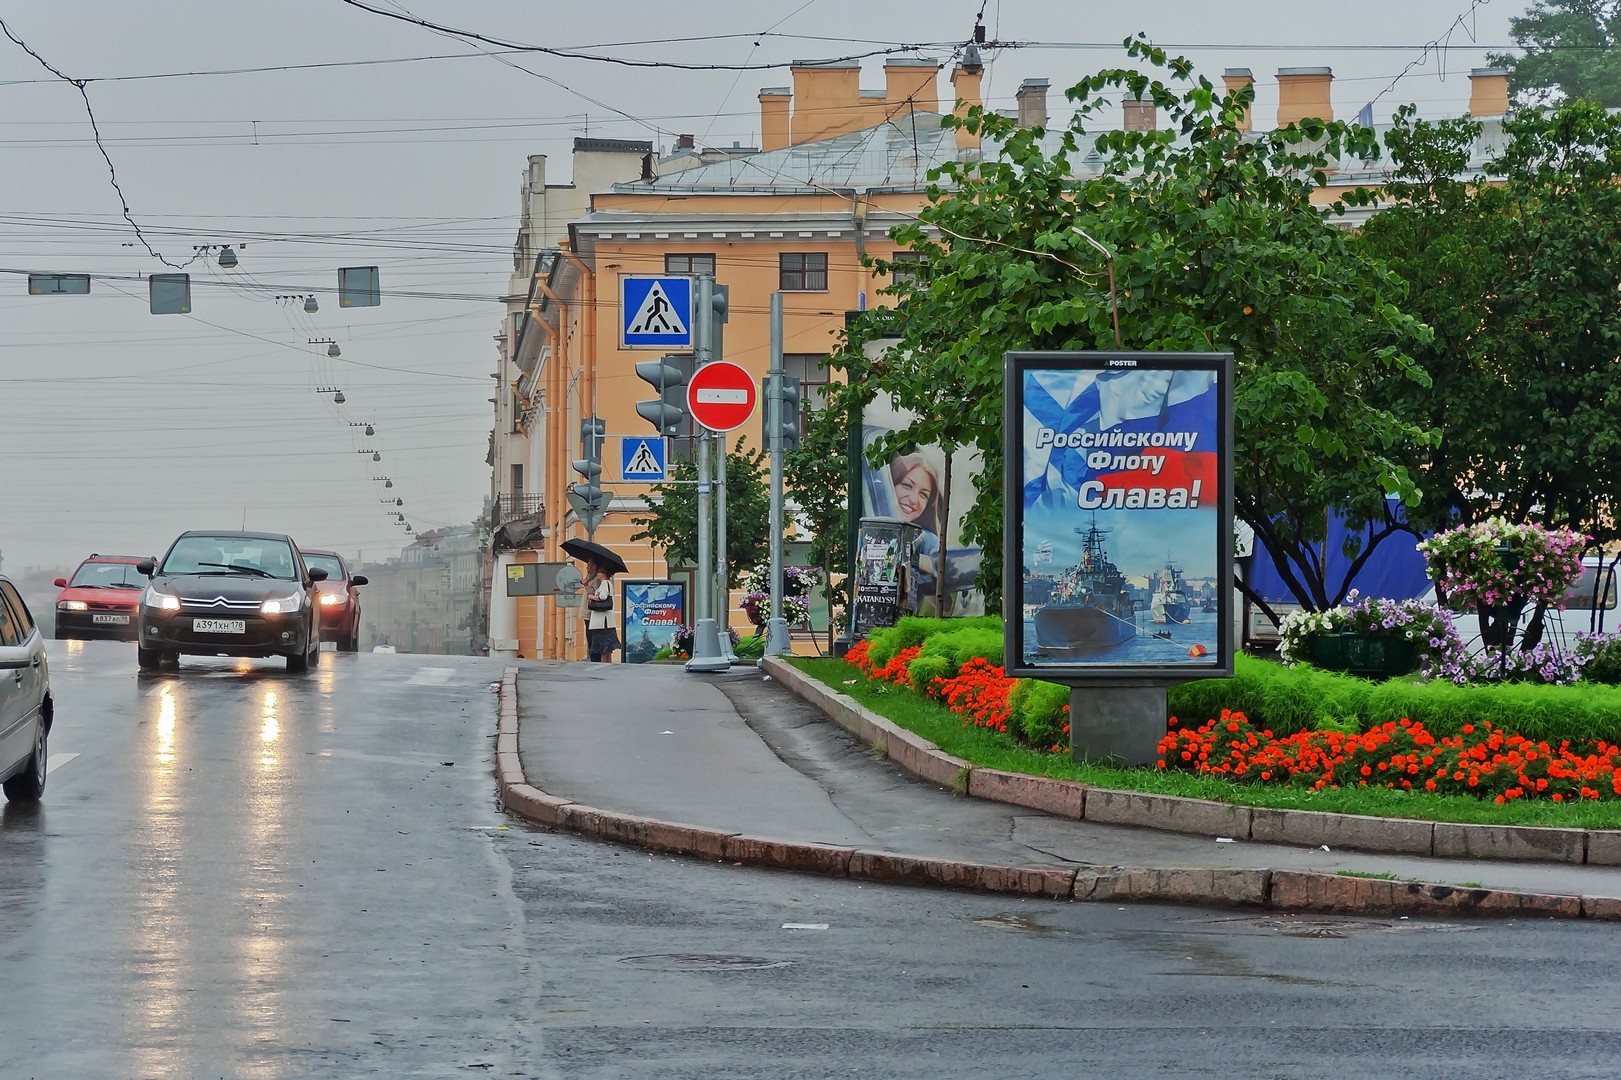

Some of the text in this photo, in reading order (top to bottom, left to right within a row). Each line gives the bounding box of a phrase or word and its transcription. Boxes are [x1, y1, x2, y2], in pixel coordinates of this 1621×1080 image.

[1036, 428, 1198, 452] Российскому
[1087, 450, 1166, 475] Флоту
[1077, 479, 1202, 510] Слава!
[857, 595, 896, 605] KATAKLYSM
[231, 621, 243, 629] 178
[641, 617, 677, 626] Слава!
